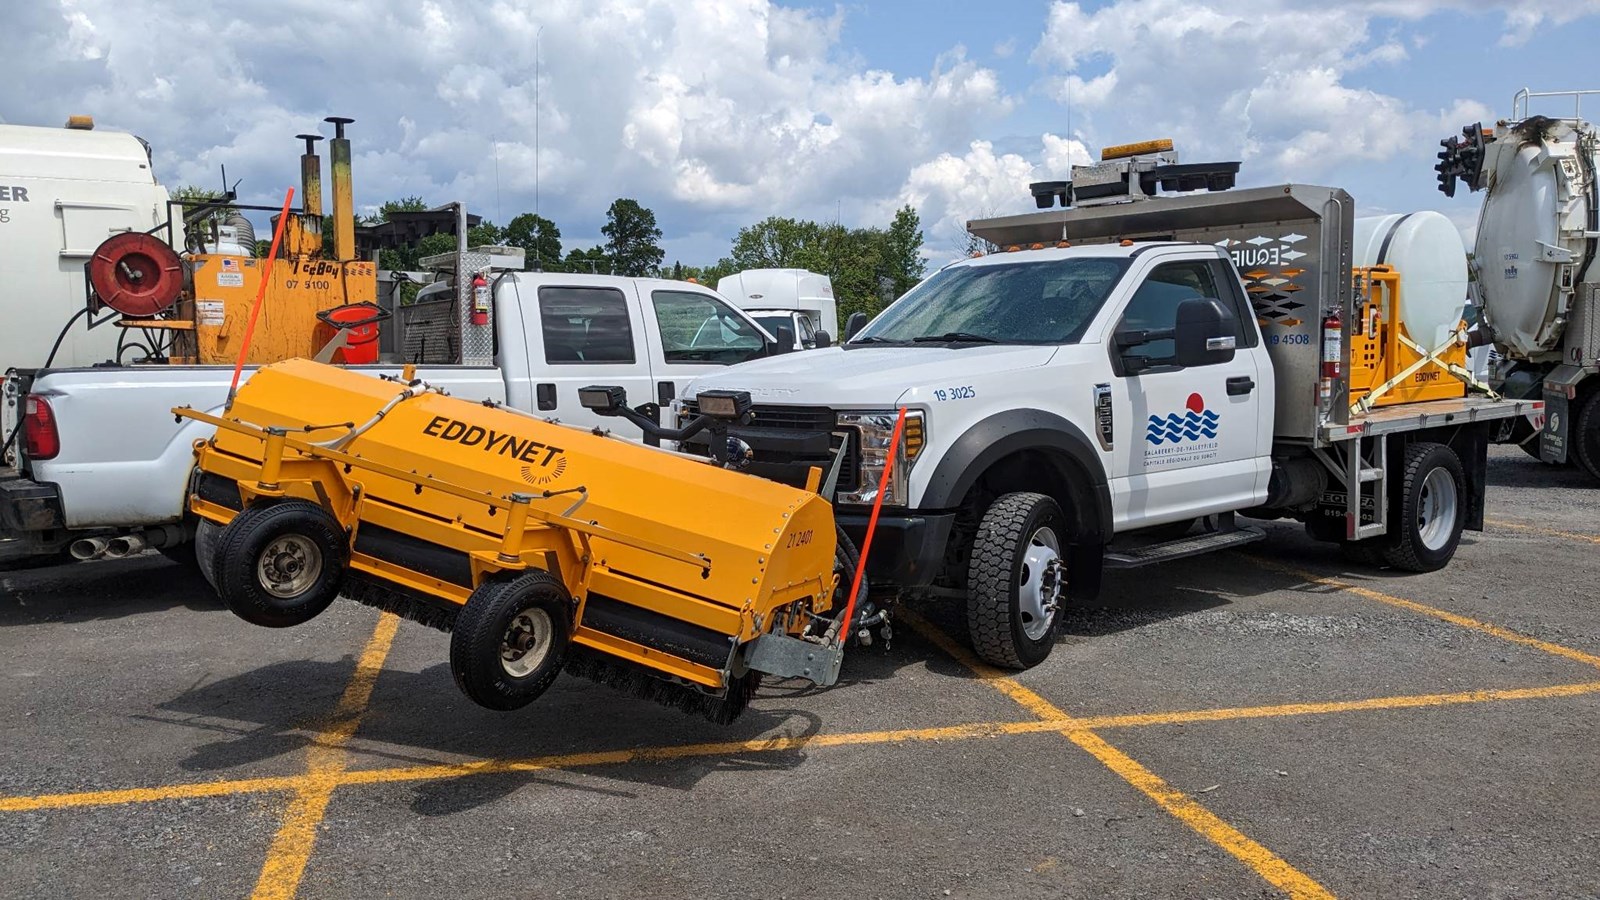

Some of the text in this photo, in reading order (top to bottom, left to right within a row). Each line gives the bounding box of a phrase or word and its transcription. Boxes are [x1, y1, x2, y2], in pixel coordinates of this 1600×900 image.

[1282, 334, 1310, 345] 4508
[933, 386, 976, 401] 19 3025
[422, 415, 565, 467] EDDYNET
